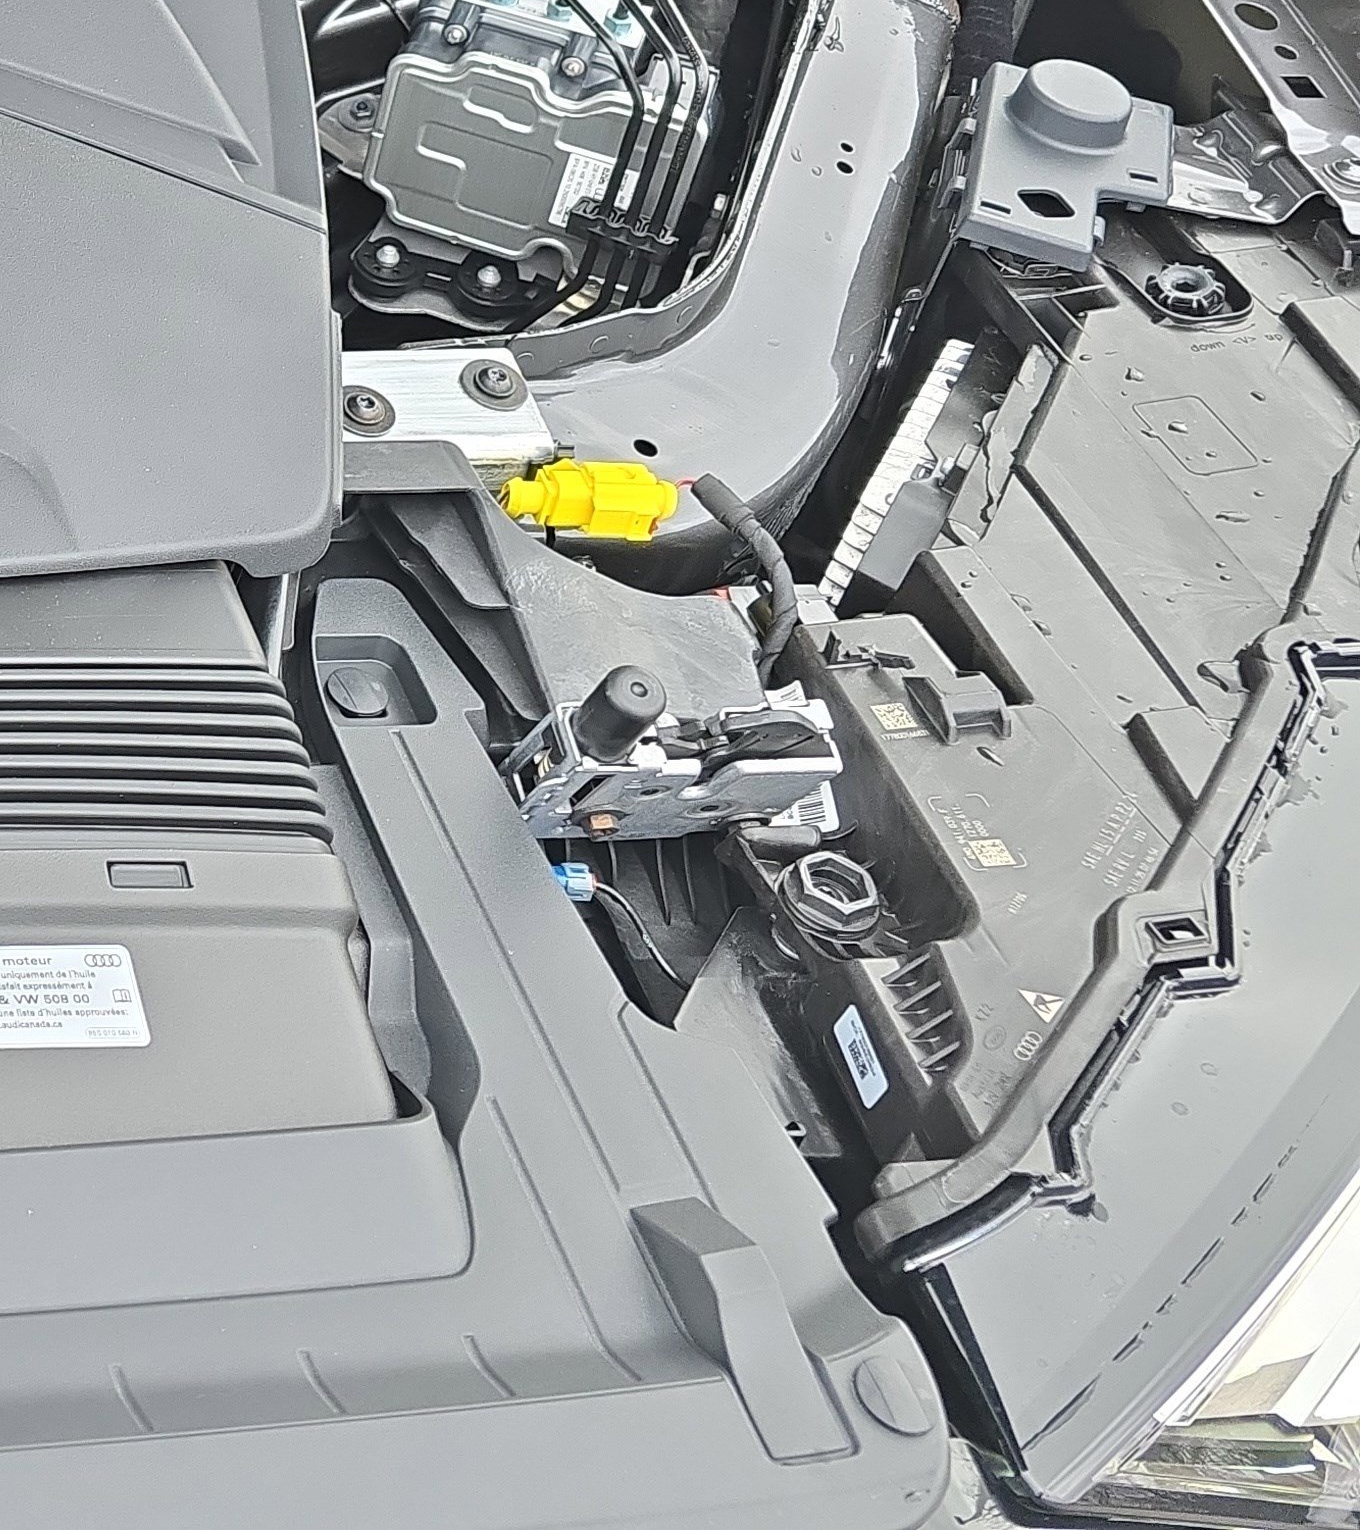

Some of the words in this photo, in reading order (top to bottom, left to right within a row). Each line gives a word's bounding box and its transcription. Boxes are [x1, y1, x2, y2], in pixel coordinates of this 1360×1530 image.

[1190, 341, 1226, 353] down
[2, 957, 53, 966] moteur
[1, 970, 54, 982] uniquement
[56, 970, 67, 978] de
[69, 969, 96, 978] l'huile
[13, 994, 39, 1004] VW
[44, 994, 69, 1004] 508
[73, 994, 90, 1003] 00
